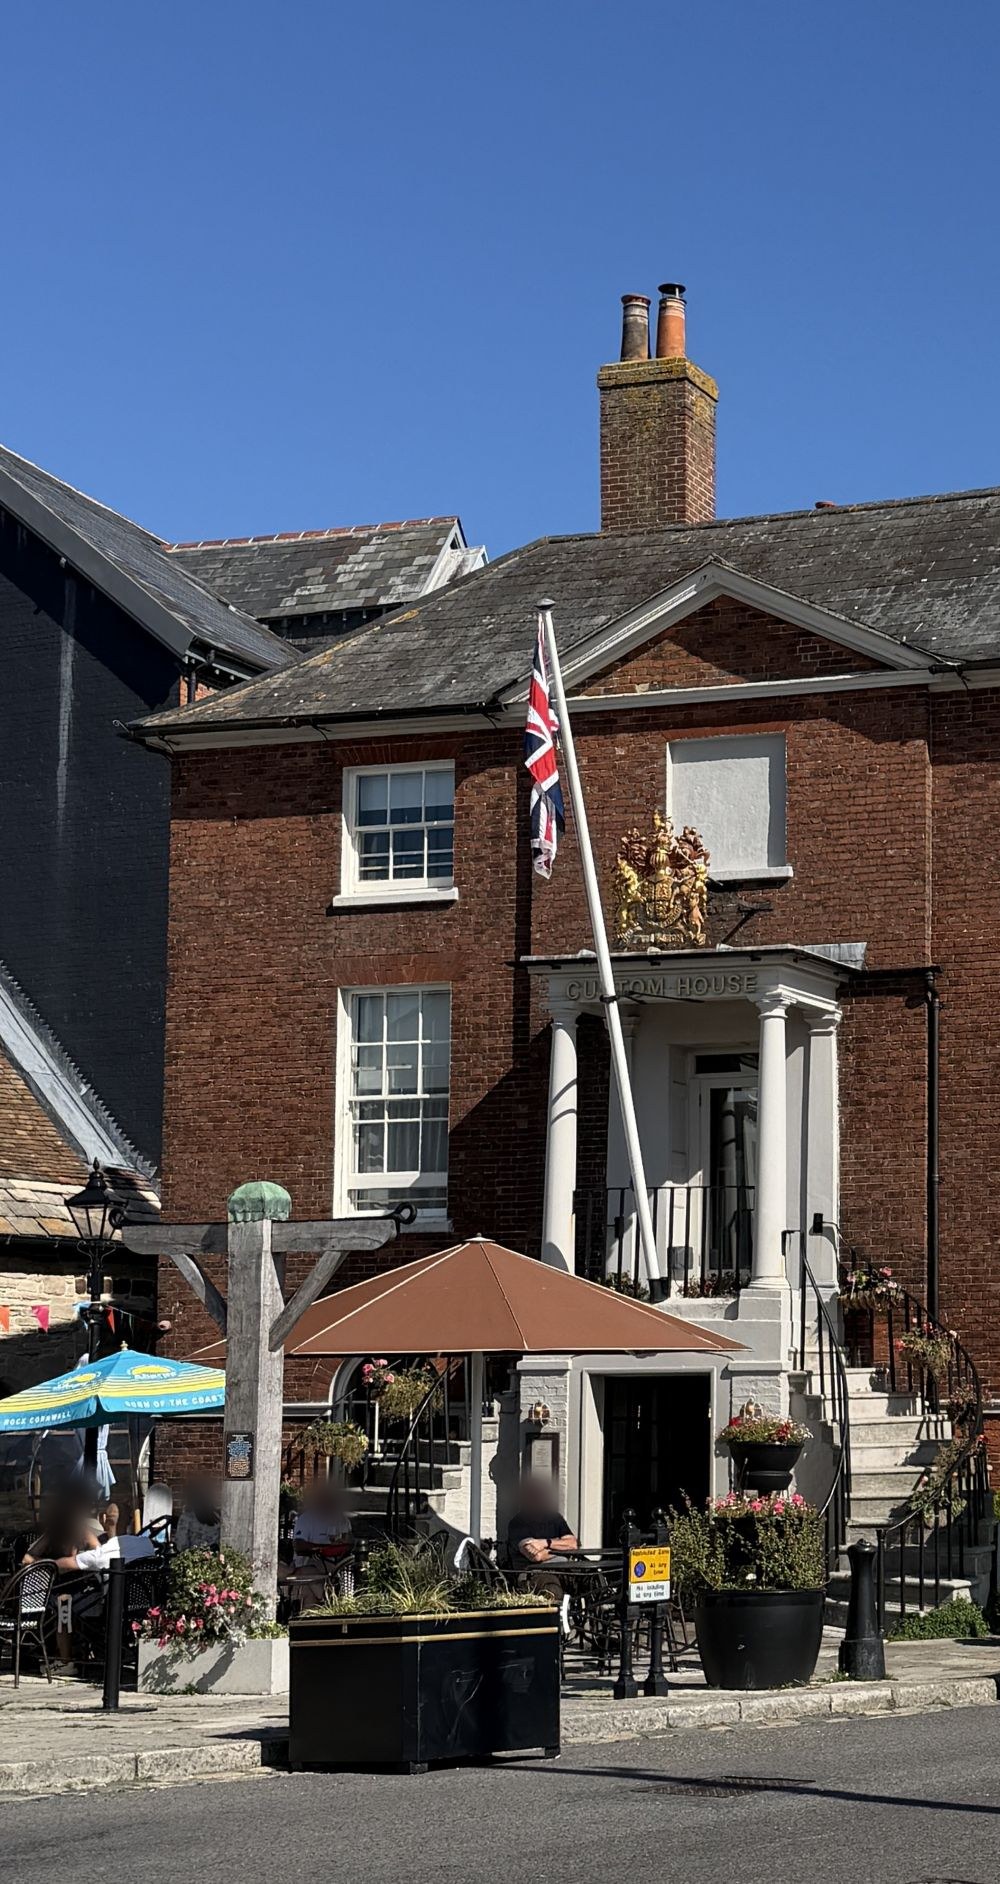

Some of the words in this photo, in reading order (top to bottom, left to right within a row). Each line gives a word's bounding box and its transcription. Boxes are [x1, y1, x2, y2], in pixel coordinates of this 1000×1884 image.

[567, 977, 665, 999] CUTOM
[678, 974, 758, 996] HOUSE
[169, 1398, 189, 1406] THE
[3, 1417, 27, 1426] ROCK
[29, 1411, 72, 1424] CORNWALL
